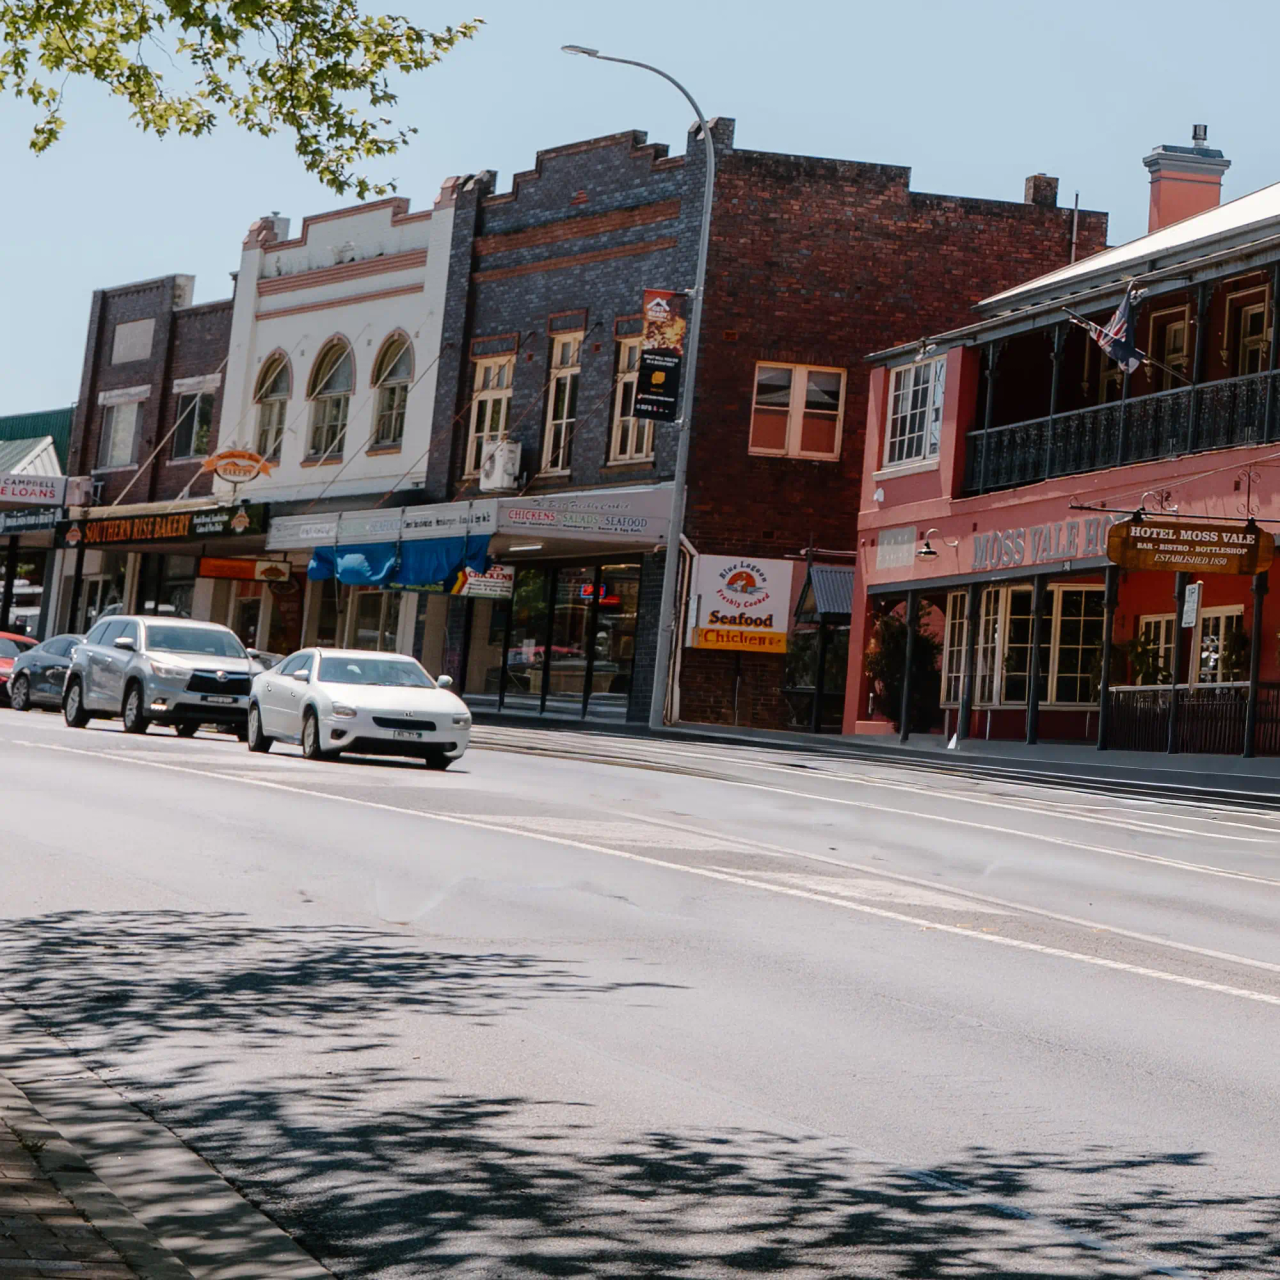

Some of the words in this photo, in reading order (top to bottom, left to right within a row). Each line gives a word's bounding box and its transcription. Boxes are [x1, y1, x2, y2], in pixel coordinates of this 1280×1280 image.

[4, 478, 56, 488] CAMPBELL
[12, 487, 56, 498] LOANS
[508, 509, 556, 521] CHICKENS
[562, 513, 598, 524] SALADS
[605, 516, 648, 528] SEAFOOD
[84, 519, 130, 544] SOUTHERN
[132, 518, 152, 540] RISE
[154, 514, 191, 538] BAKERY
[1130, 526, 1177, 540] HOTEL
[1180, 529, 1219, 542] MOSS
[1221, 532, 1256, 545] VALE
[972, 528, 1026, 570] MOSS
[1030, 521, 1080, 563] VALE
[1136, 542, 1154, 550] BAR
[1159, 544, 1190, 552] BISTRO
[1195, 546, 1248, 556] BOTTLESHOP
[1154, 554, 1209, 565] ESTABLISHED
[1210, 556, 1228, 566] 1850
[719, 564, 738, 580] Blue
[740, 560, 767, 582] Lagoon
[716, 588, 741, 608] Freshly
[744, 592, 770, 608] Cooked
[708, 610, 774, 628] Seafood
[704, 629, 775, 646] Chickens
